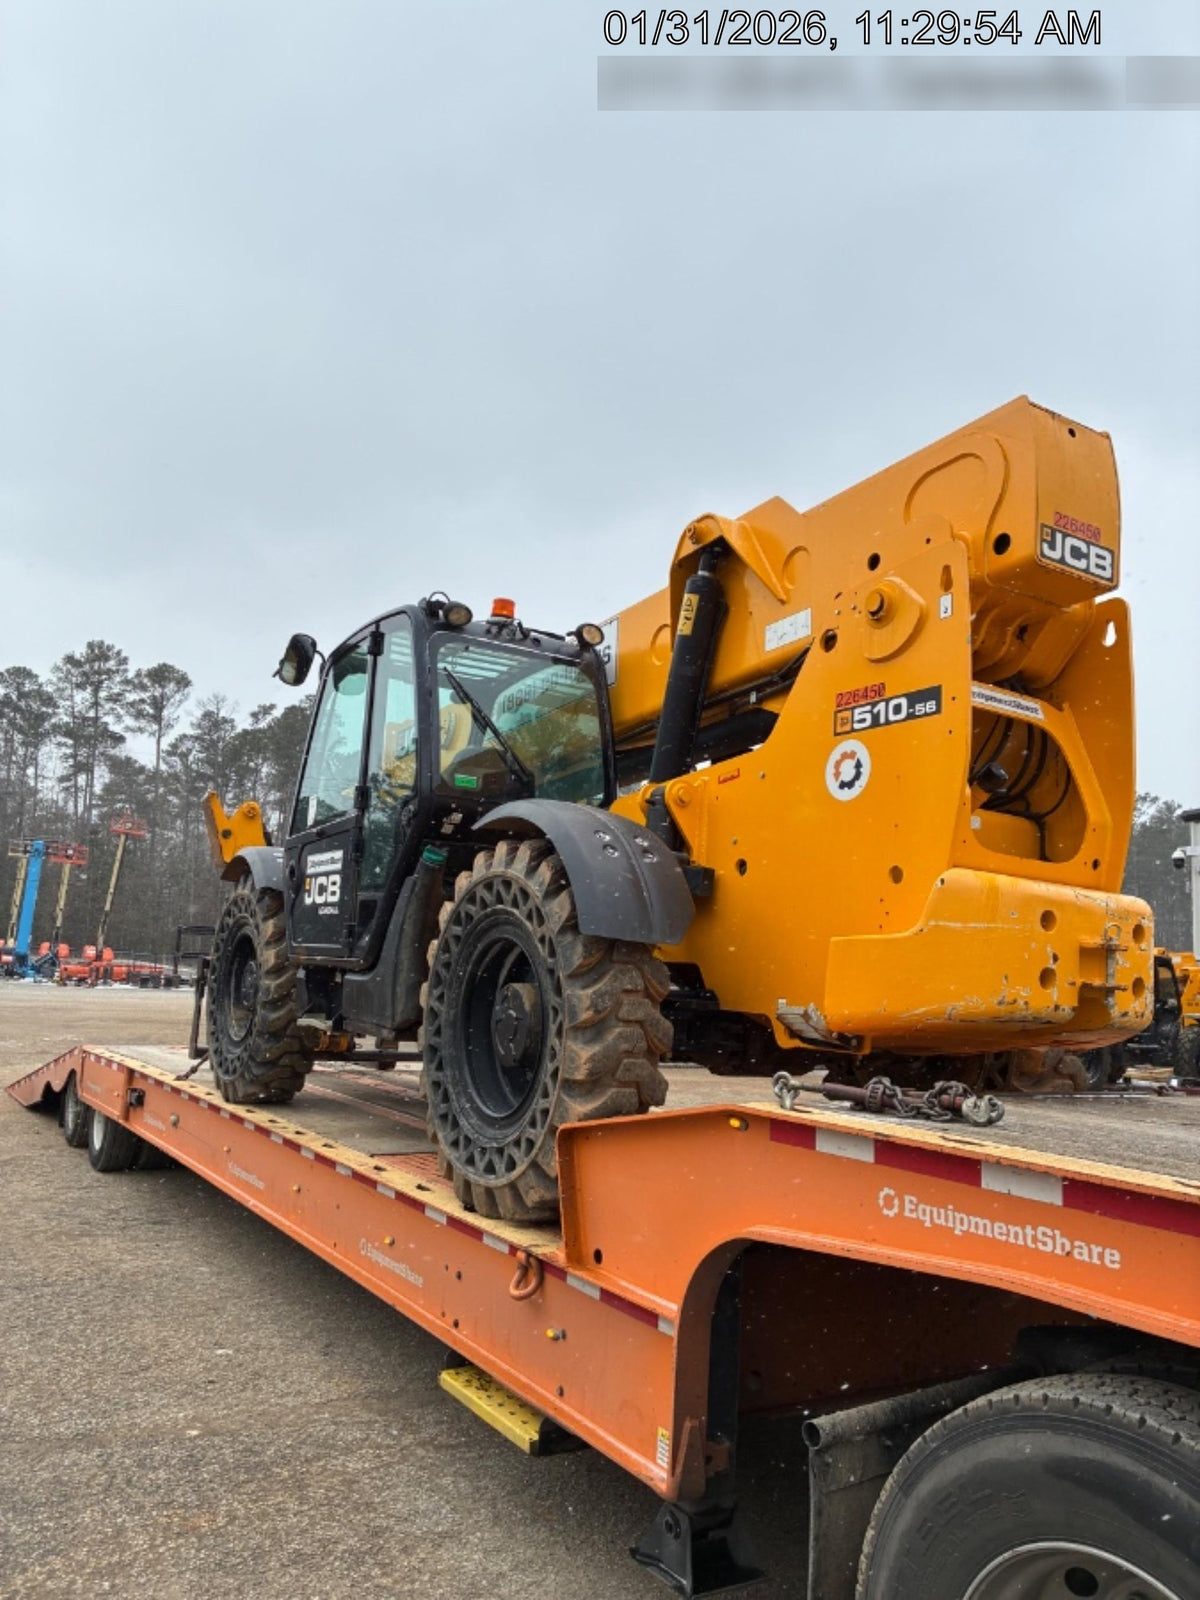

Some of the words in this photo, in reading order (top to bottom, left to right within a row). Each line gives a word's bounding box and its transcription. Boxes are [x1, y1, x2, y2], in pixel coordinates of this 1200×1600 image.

[1054, 511, 1102, 542] 226450
[1042, 530, 1112, 579] JCB
[836, 682, 887, 708] 226450
[304, 874, 341, 905] JCB
[903, 1194, 1121, 1270] EquipmentShare
